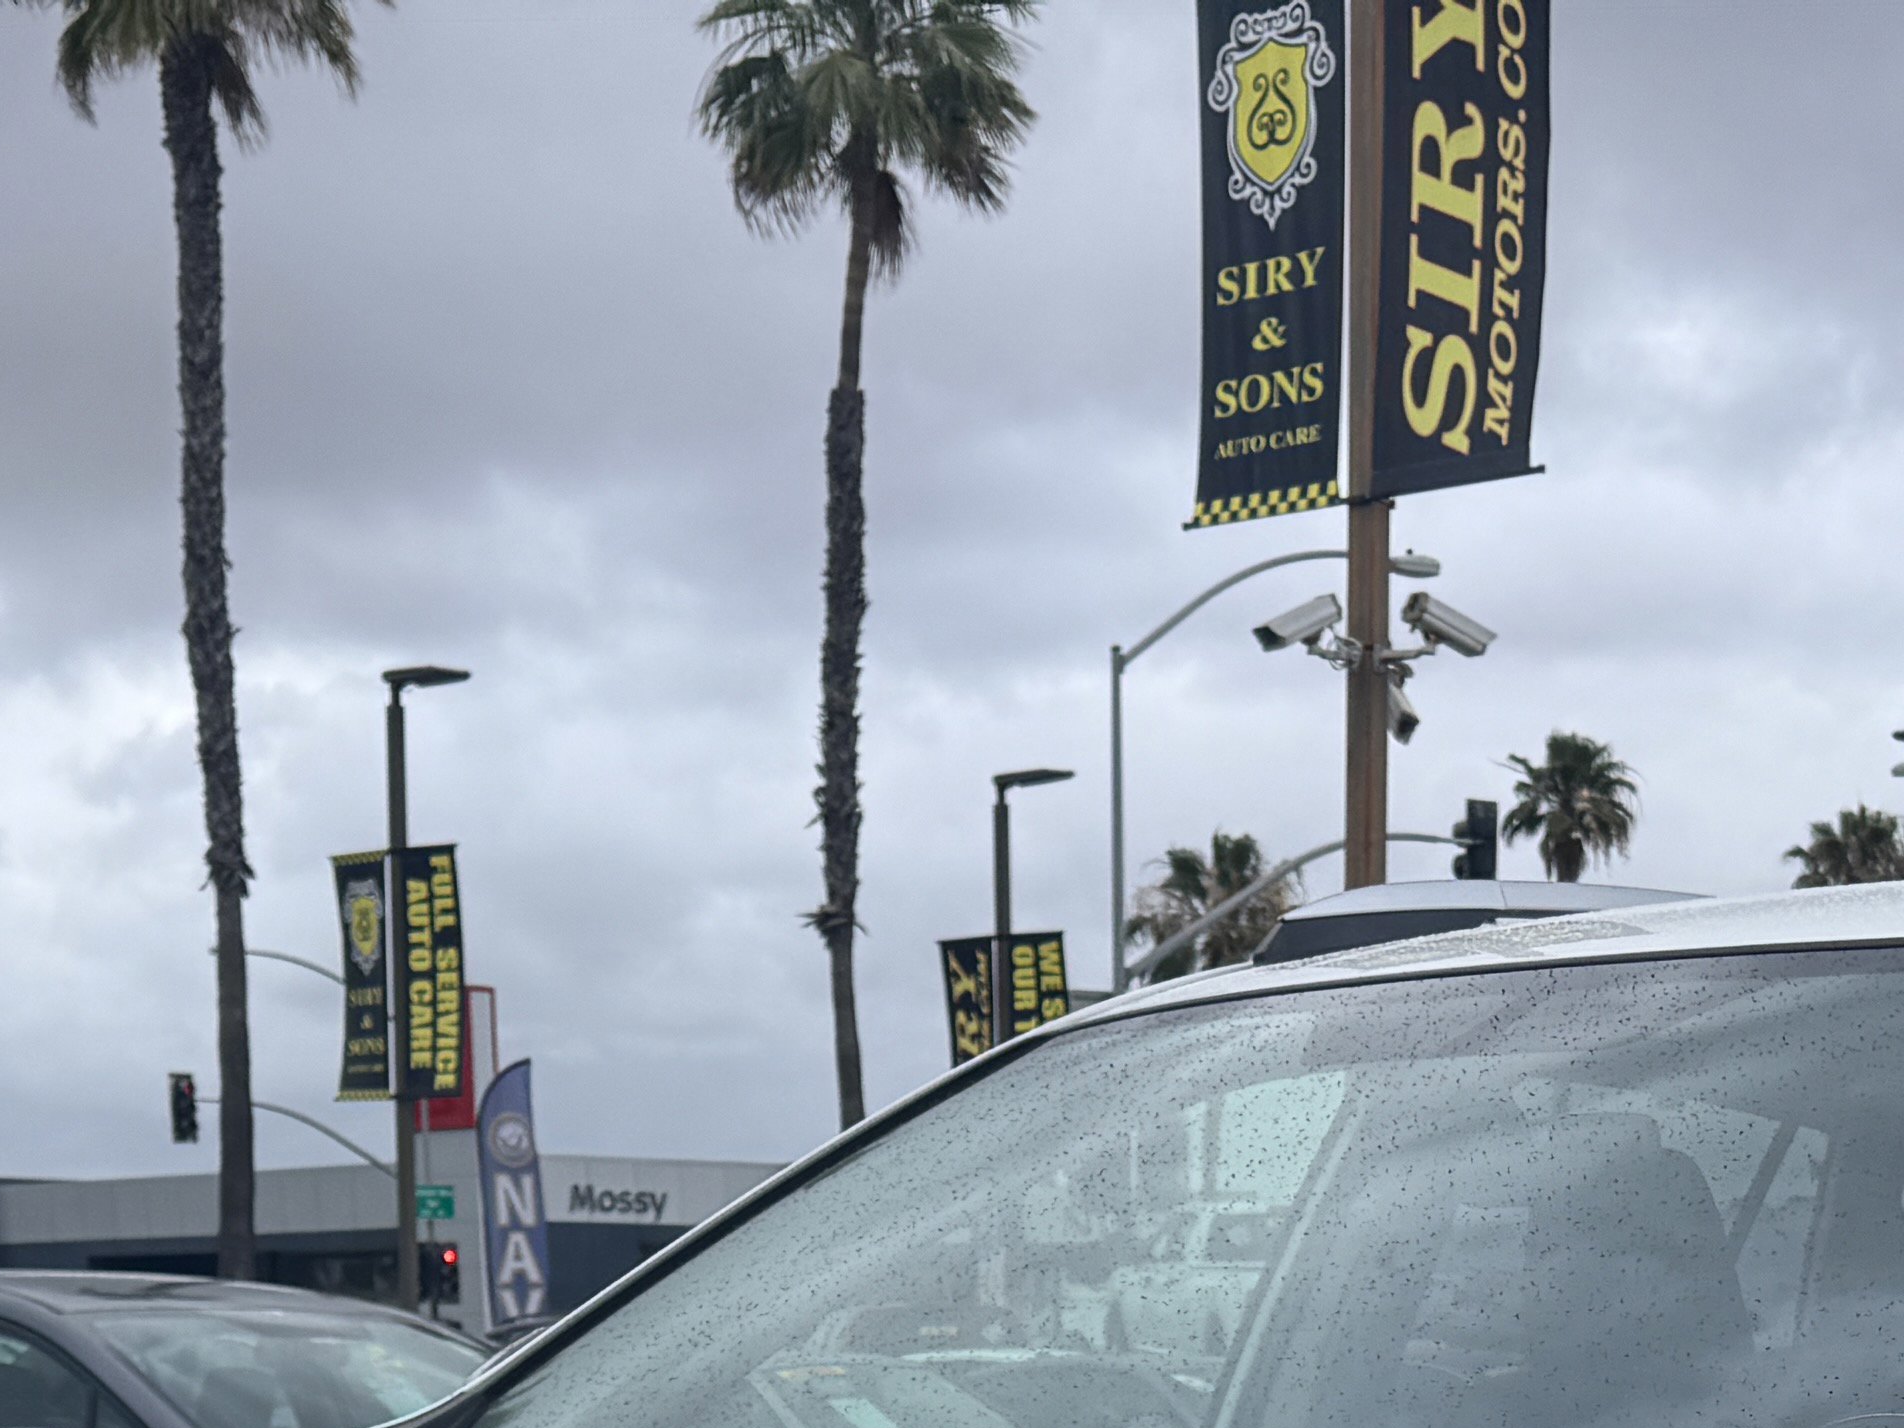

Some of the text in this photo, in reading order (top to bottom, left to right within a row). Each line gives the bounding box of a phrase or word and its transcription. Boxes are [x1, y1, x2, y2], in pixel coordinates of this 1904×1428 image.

[1402, 0, 1486, 455] SIRY
[1215, 246, 1326, 307] SIRY
[1251, 316, 1288, 352] &
[1213, 362, 1325, 420] SONS
[1213, 424, 1322, 461] AUTO CARE
[405, 878, 434, 1070] AUTO CARE
[429, 853, 460, 1091] FULL SERVICE
[1012, 944, 1038, 1011] OUR
[1038, 940, 1063, 992] WE
[568, 1184, 669, 1225] Mossy
